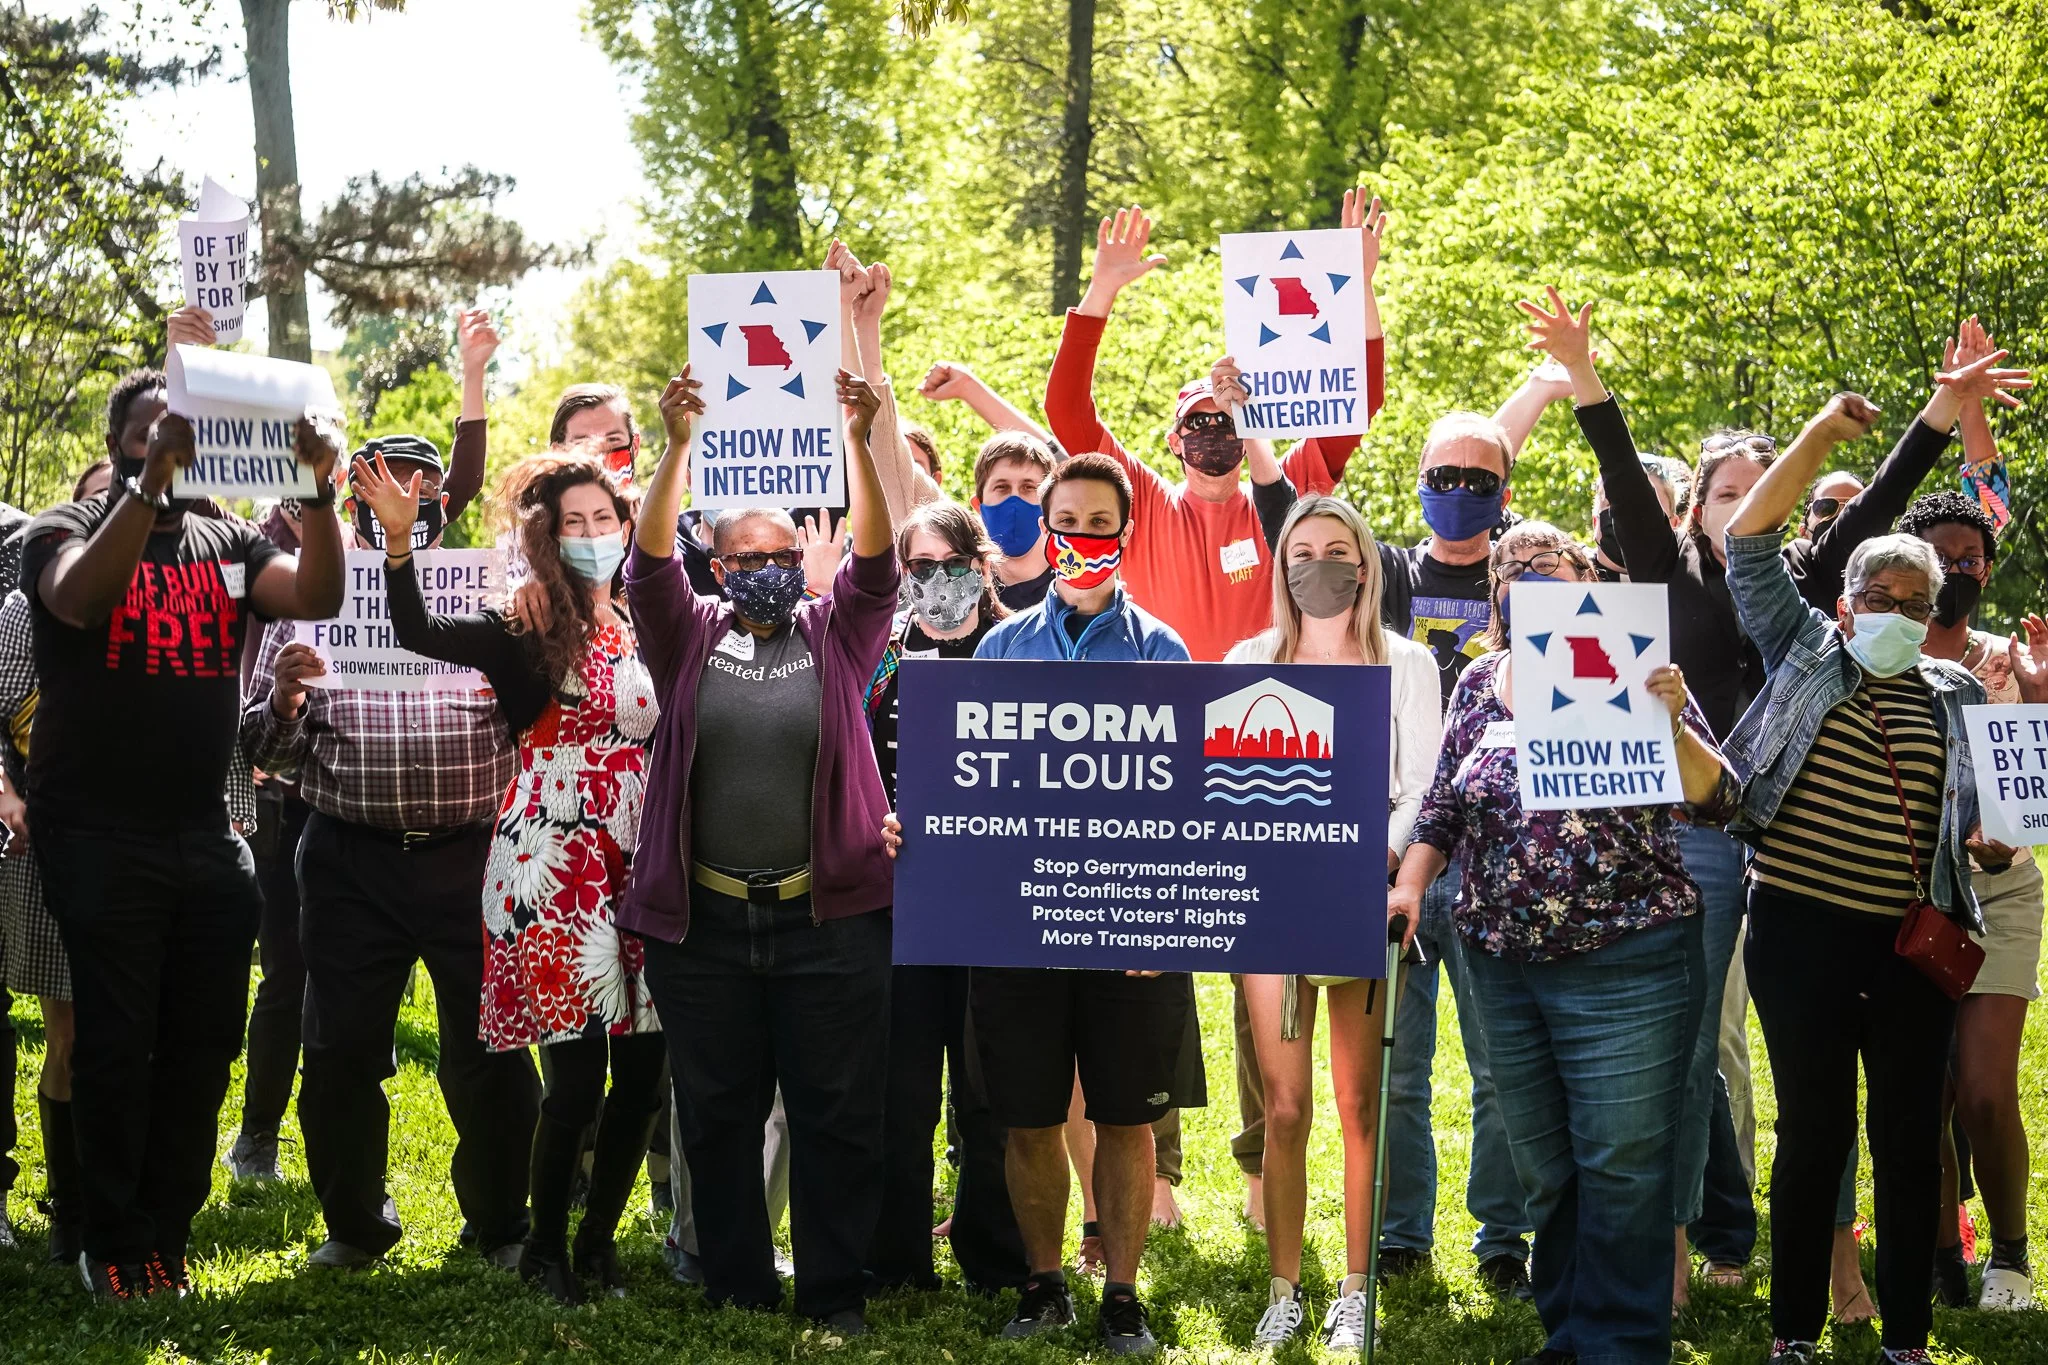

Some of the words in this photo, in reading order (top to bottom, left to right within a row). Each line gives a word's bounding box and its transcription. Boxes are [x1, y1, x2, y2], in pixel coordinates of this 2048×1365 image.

[194, 236, 216, 257] OF
[195, 262, 219, 283] BY
[227, 257, 246, 281] TH
[197, 287, 234, 308] FOR
[1238, 369, 1312, 397] SHOW
[1320, 367, 1357, 393] ME
[1242, 398, 1356, 429] INTEGRITY
[187, 416, 254, 448] HOW
[261, 418, 297, 449] ME
[702, 428, 784, 459] SHOW
[792, 427, 833, 457] ME
[183, 452, 300, 485] INTEGRITY
[704, 464, 832, 496] INTEGRITY
[353, 567, 387, 591] TH
[415, 567, 489, 590] EOPLE
[1229, 566, 1254, 585] STAFF
[163, 592, 206, 615] JOINT
[106, 605, 238, 677] FREE
[315, 624, 357, 648] FOR
[332, 660, 471, 676] SHOWMEINTEGRITY.ORG
[707, 655, 764, 681] reated
[768, 651, 815, 680] equal
[956, 701, 1178, 743] REFORM
[1987, 720, 2018, 743] OF
[1528, 739, 1612, 766] SHOW
[1621, 740, 1665, 765] ME
[1993, 748, 2024, 771] BY
[953, 750, 1021, 788] ST.
[1039, 752, 1174, 791] LOUIS
[1532, 769, 1666, 798] INTEGRITY
[1998, 775, 2048, 801] FOR
[925, 815, 1028, 837] REFORM
[1034, 817, 1081, 838] THE
[1087, 818, 1176, 839] BOARD
[1182, 820, 1216, 841] OF
[1221, 821, 1359, 843] ALDERMEN
[1033, 857, 1080, 878] Stop
[1084, 858, 1247, 881] Gerrymandering
[1020, 881, 1058, 897] Ban
[1062, 882, 1152, 900] Conflicts
[1156, 883, 1178, 900] of
[1182, 884, 1260, 902] Interest
[1032, 905, 1105, 922] Protect
[1109, 907, 1179, 925] Voters'
[1184, 908, 1247, 928] Rights
[1041, 929, 1093, 946] More
[1097, 930, 1236, 953] Transparency
